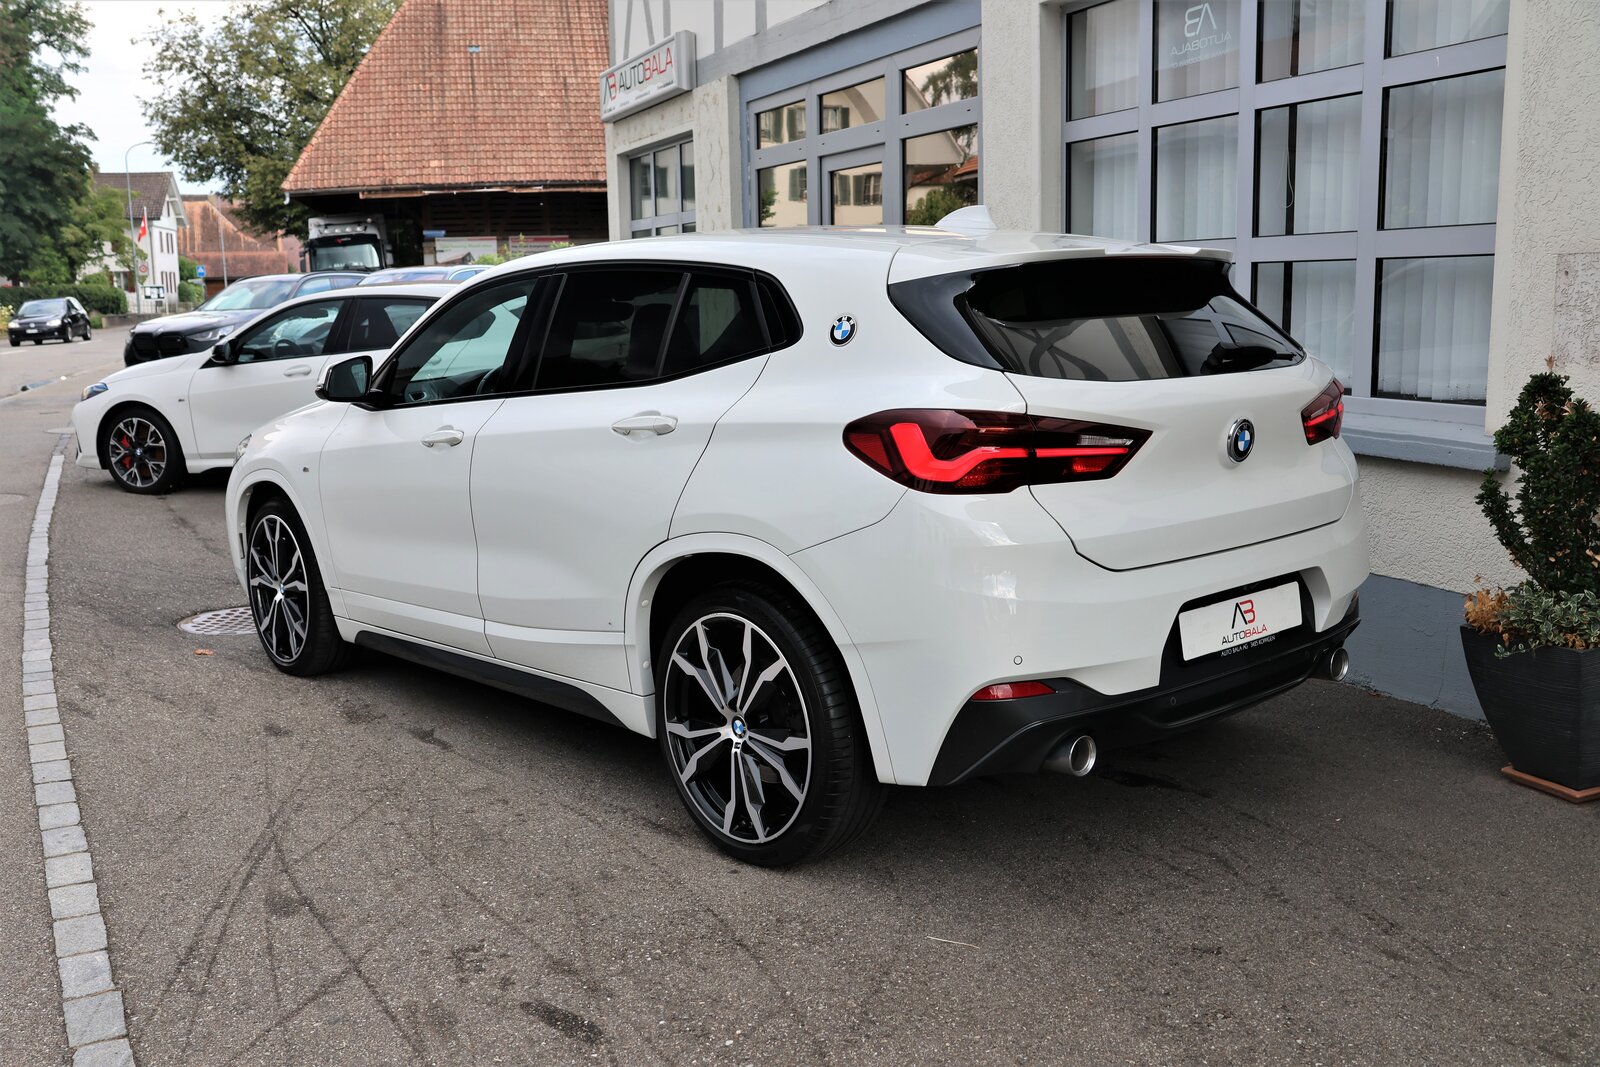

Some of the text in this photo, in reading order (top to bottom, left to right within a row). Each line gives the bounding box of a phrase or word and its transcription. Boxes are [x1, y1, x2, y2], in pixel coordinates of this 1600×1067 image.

[618, 47, 673, 93] AUTOBALA
[1221, 624, 1268, 645] AUTOBALA
[1221, 648, 1232, 657] AUTO
[1232, 645, 1243, 654] BALA
